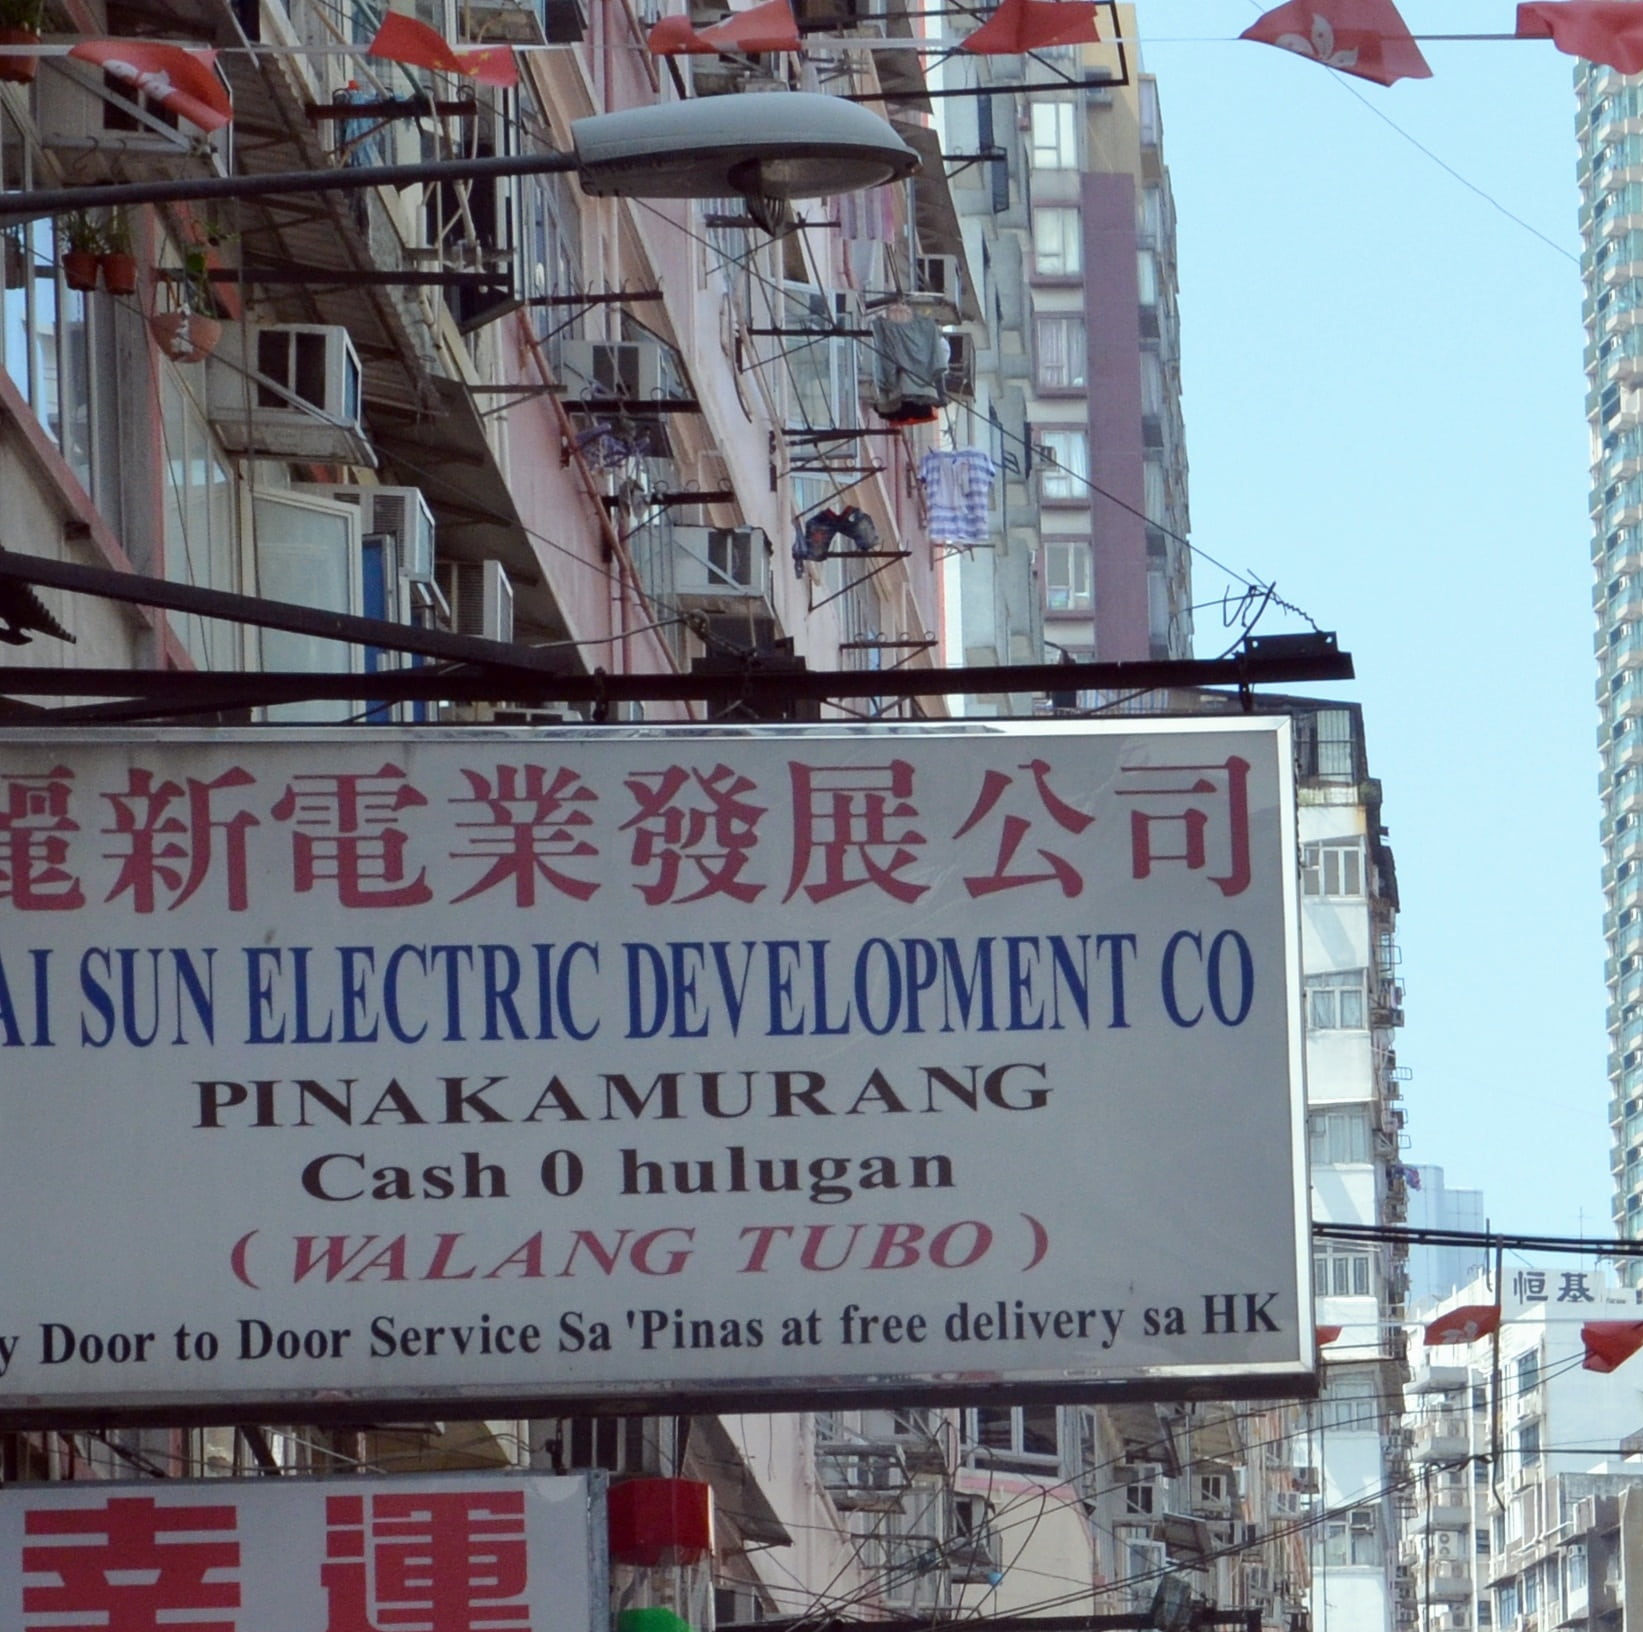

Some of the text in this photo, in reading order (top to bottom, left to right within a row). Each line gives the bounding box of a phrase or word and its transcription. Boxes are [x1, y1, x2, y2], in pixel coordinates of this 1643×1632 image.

[80, 946, 219, 1048] SUN
[242, 941, 600, 1045] ELECTRIC
[623, 932, 1137, 1039] DEVELOPMENT
[1161, 929, 1254, 1028] CO
[193, 1062, 1055, 1128] PINAKAMURANG
[302, 1151, 510, 1200] Cash
[619, 1147, 955, 1204] hulugan
[292, 1227, 696, 1284] WALANG
[736, 1219, 993, 1273] TUBO
[1513, 1270, 1595, 1304] 恒基
[38, 1322, 155, 1364] Door
[173, 1322, 219, 1362] to
[236, 1317, 350, 1360] Door
[370, 1313, 540, 1358] Service
[558, 1310, 611, 1353] Sa
[625, 1308, 763, 1350] 'Pinas
[781, 1308, 822, 1346] at
[840, 1303, 926, 1345] free
[945, 1300, 1124, 1349] delivery
[1143, 1305, 1186, 1337] sa
[1201, 1292, 1281, 1334] HK
